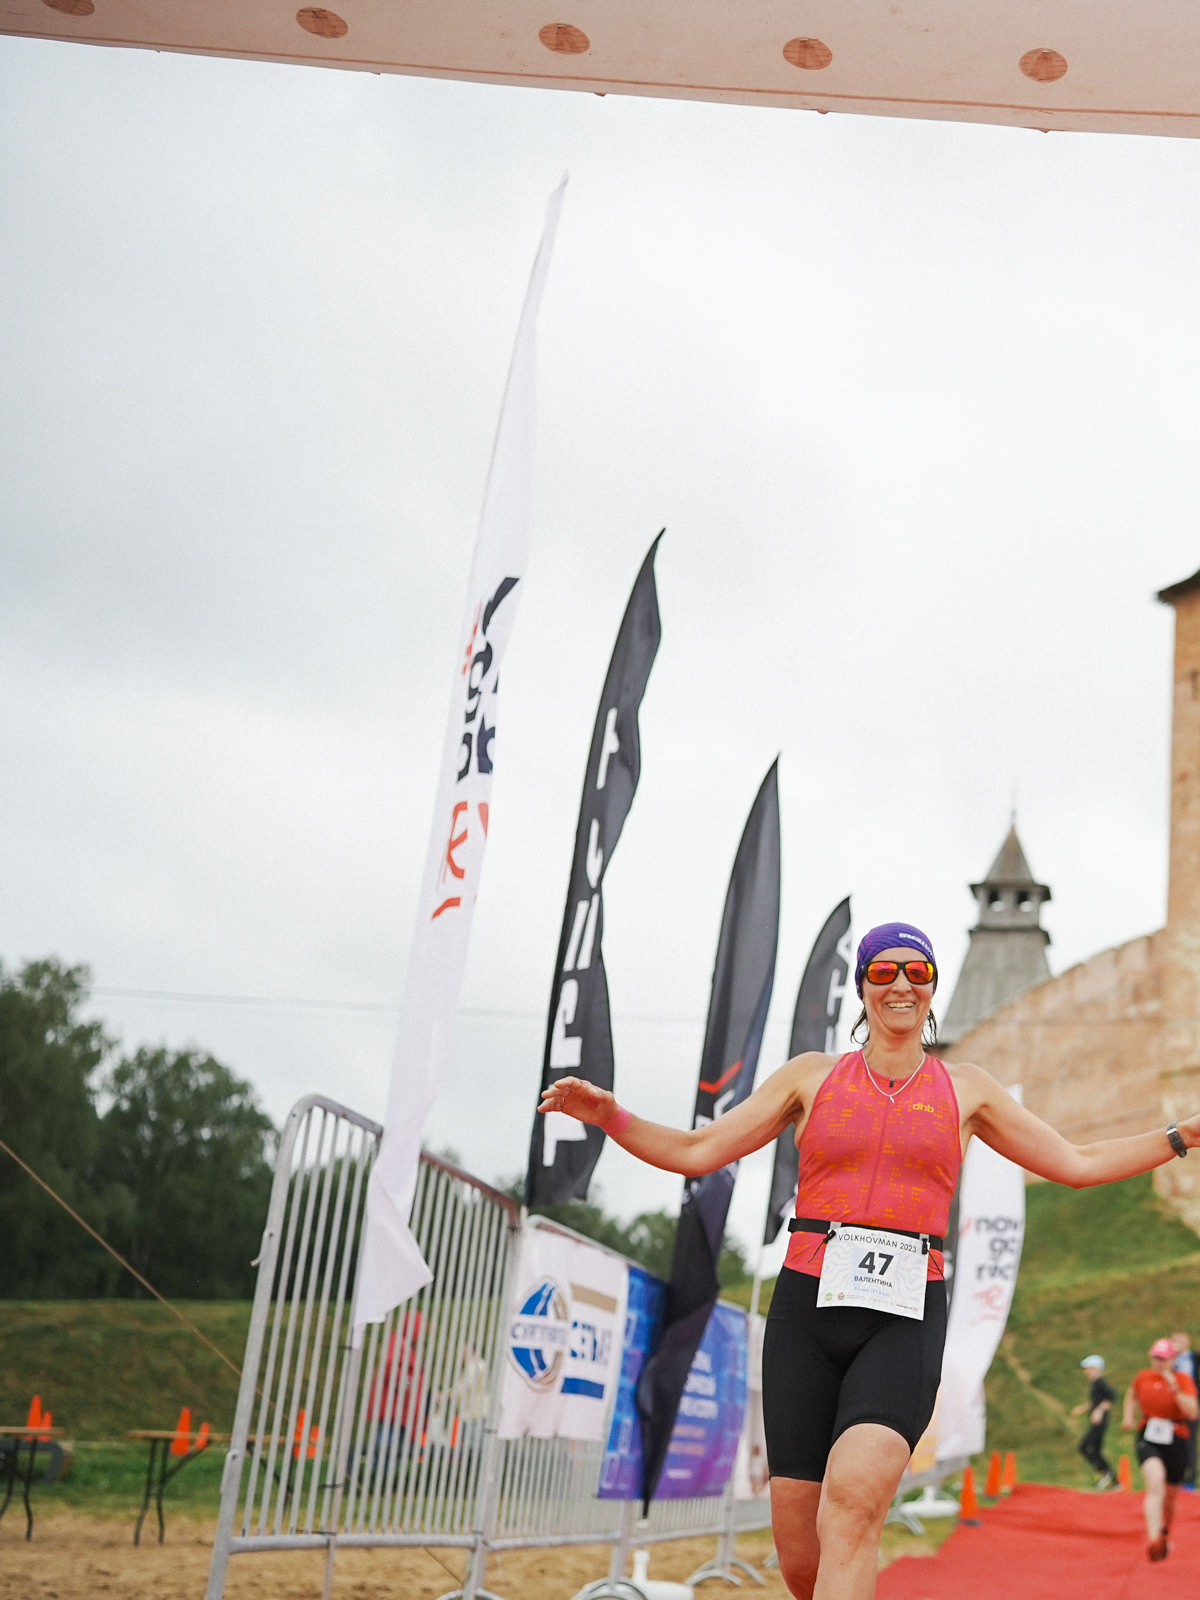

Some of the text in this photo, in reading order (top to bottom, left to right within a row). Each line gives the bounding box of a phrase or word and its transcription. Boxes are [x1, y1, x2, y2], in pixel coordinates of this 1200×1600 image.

[912, 1102, 935, 1113] dhb
[838, 1233, 917, 1254] VOLKHOVMAN 2023
[858, 1251, 895, 1276] 47
[853, 1275, 893, 1288] ВАЛЕНТИНА
